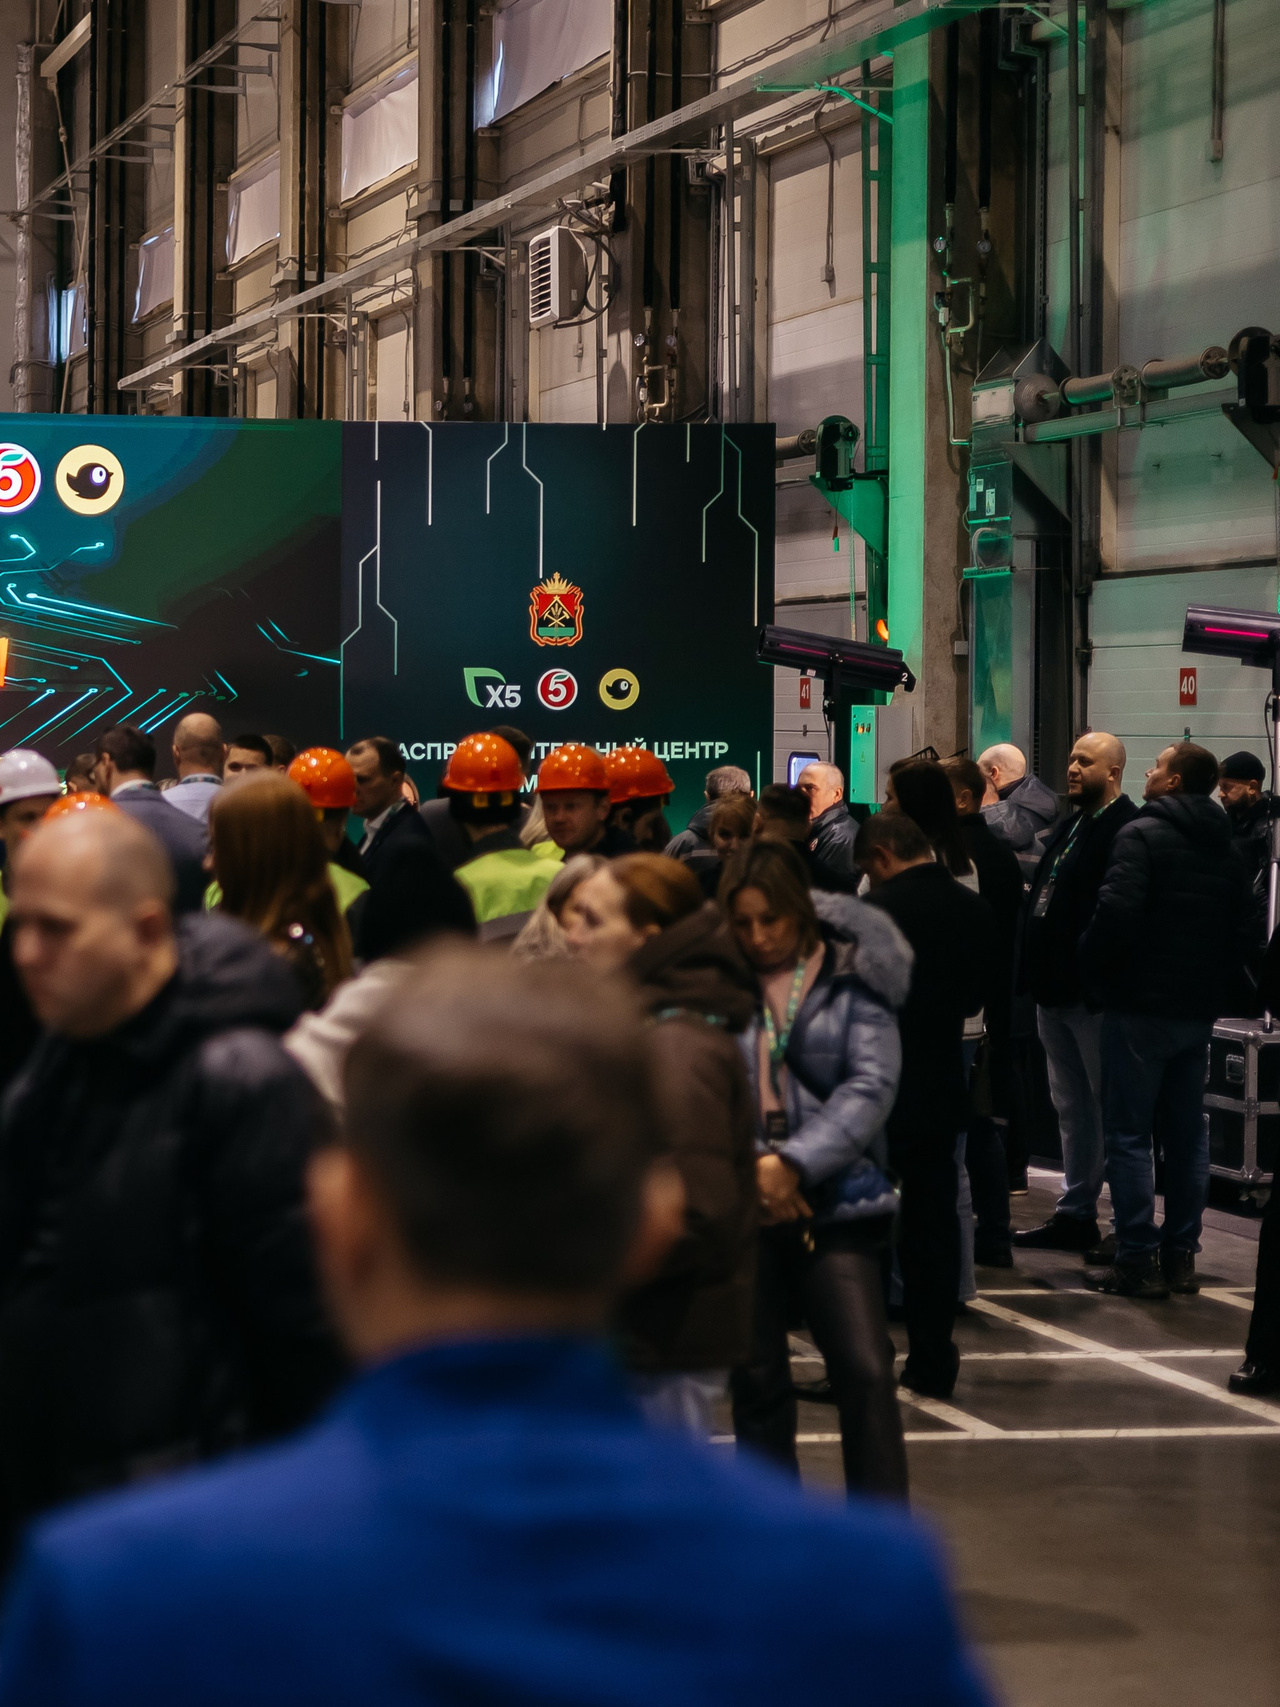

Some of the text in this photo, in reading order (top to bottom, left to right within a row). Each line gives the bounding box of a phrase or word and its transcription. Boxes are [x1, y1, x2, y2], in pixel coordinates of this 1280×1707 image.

[901, 672, 908, 682] 2
[1180, 675, 1195, 695] 40
[485, 685, 521, 708] X5
[801, 683, 810, 700] 41
[654, 741, 730, 762] ЦЕНТР
